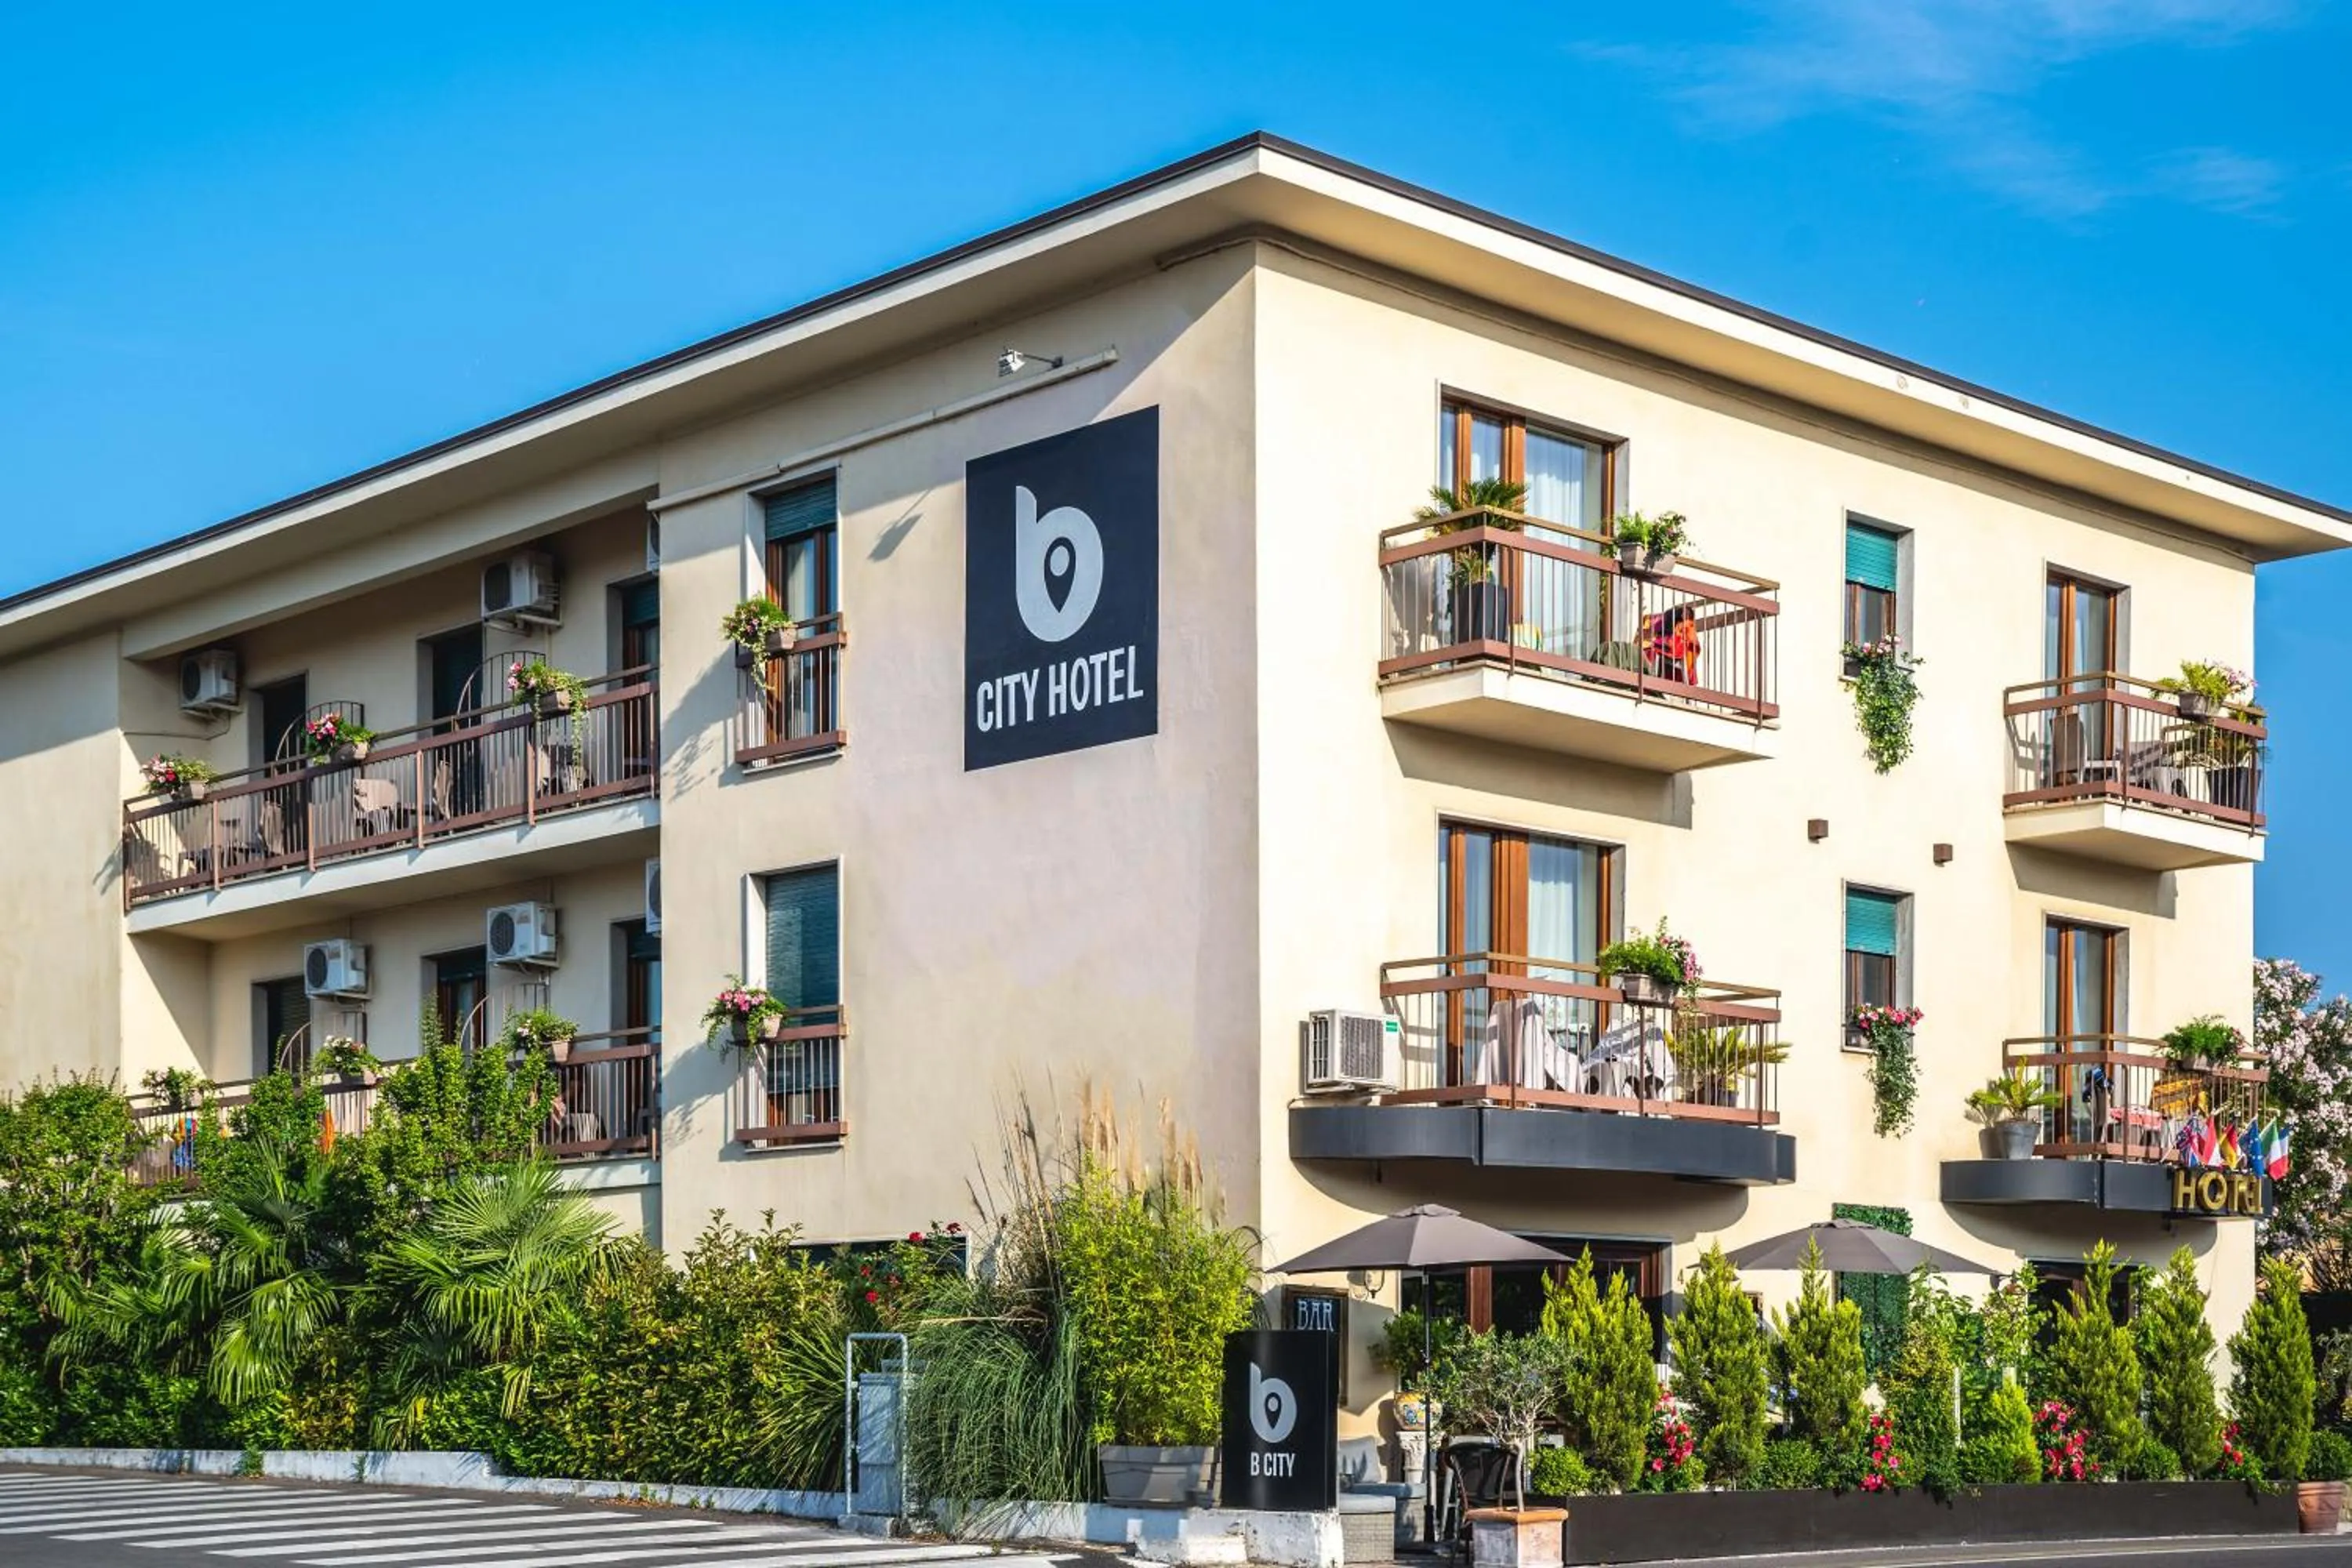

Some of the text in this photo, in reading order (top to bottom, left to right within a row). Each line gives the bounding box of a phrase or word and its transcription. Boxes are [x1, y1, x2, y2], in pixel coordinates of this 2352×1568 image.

[976, 645, 1144, 733] CITY HOTEL
[2173, 1169, 2264, 1215] HOTEL
[1297, 1299, 1334, 1333] BAR
[1250, 1452, 1296, 1478] B CITY
